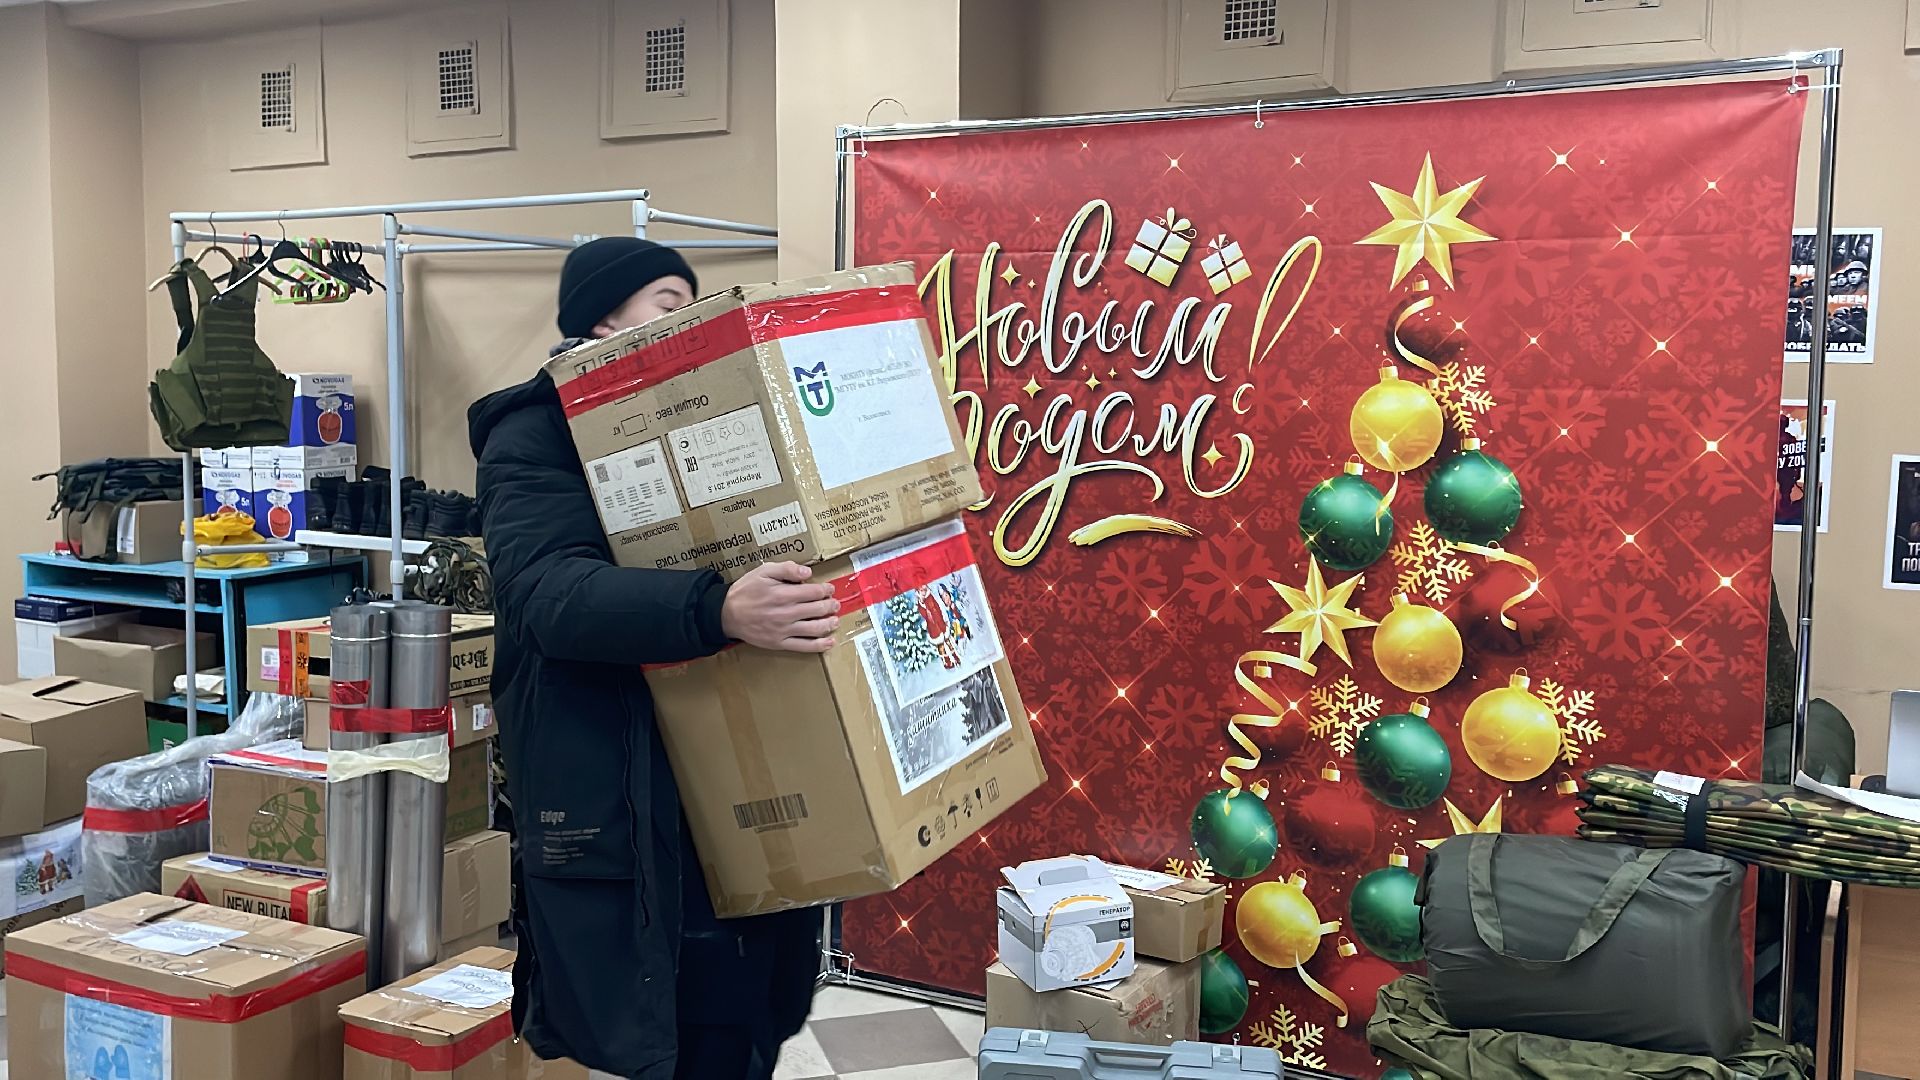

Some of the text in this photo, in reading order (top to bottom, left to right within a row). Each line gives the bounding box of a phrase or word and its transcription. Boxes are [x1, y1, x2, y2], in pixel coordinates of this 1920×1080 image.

[672, 394, 709, 413] Общий
[654, 407, 672, 419] вес
[725, 471, 761, 487] Меркурий
[814, 506, 839, 521] RUSSIA
[654, 530, 753, 570] переменного тока
[747, 537, 805, 565] Счетчики
[540, 810, 566, 826] Edge
[227, 894, 254, 914] NEW
[1099, 905, 1131, 917] ГЕНЕРАТОР
